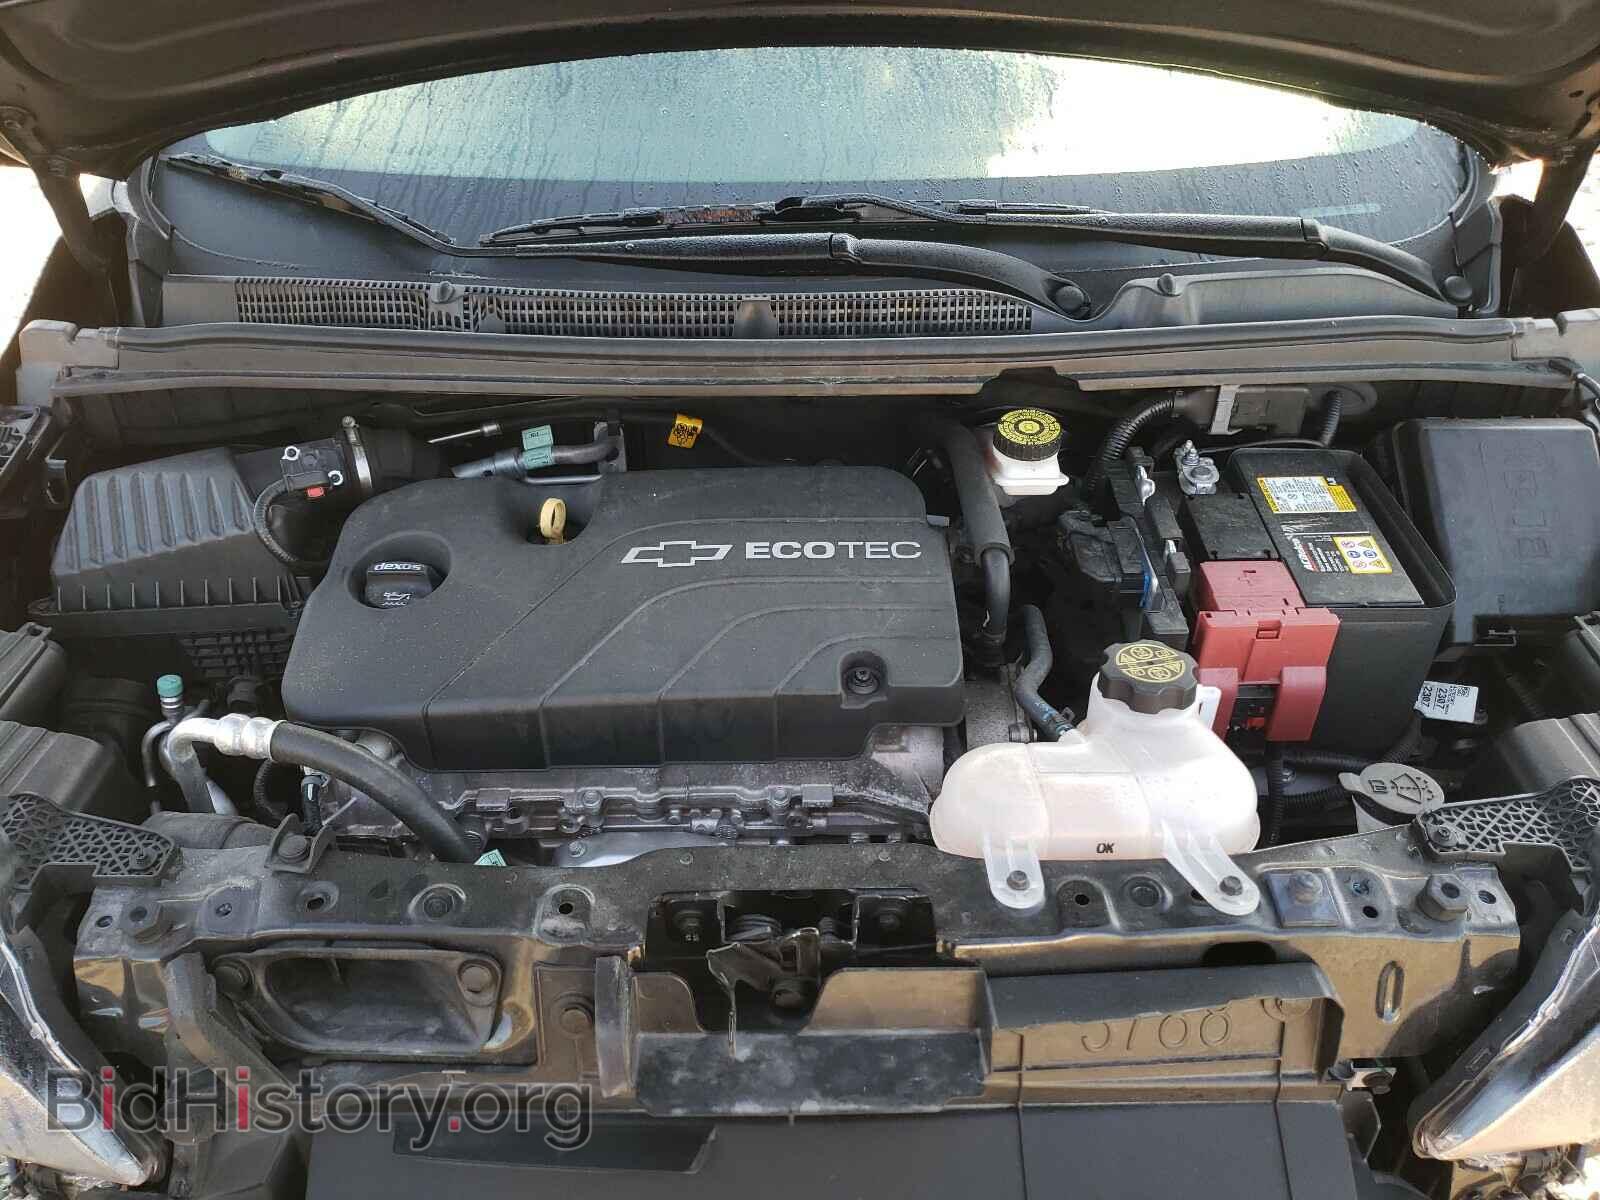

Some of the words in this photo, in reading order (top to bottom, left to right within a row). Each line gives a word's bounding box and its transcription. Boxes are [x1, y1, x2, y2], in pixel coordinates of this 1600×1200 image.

[745, 541, 922, 559] ECOTEC
[374, 562, 423, 571] dexos
[1096, 842, 1114, 854] OK
